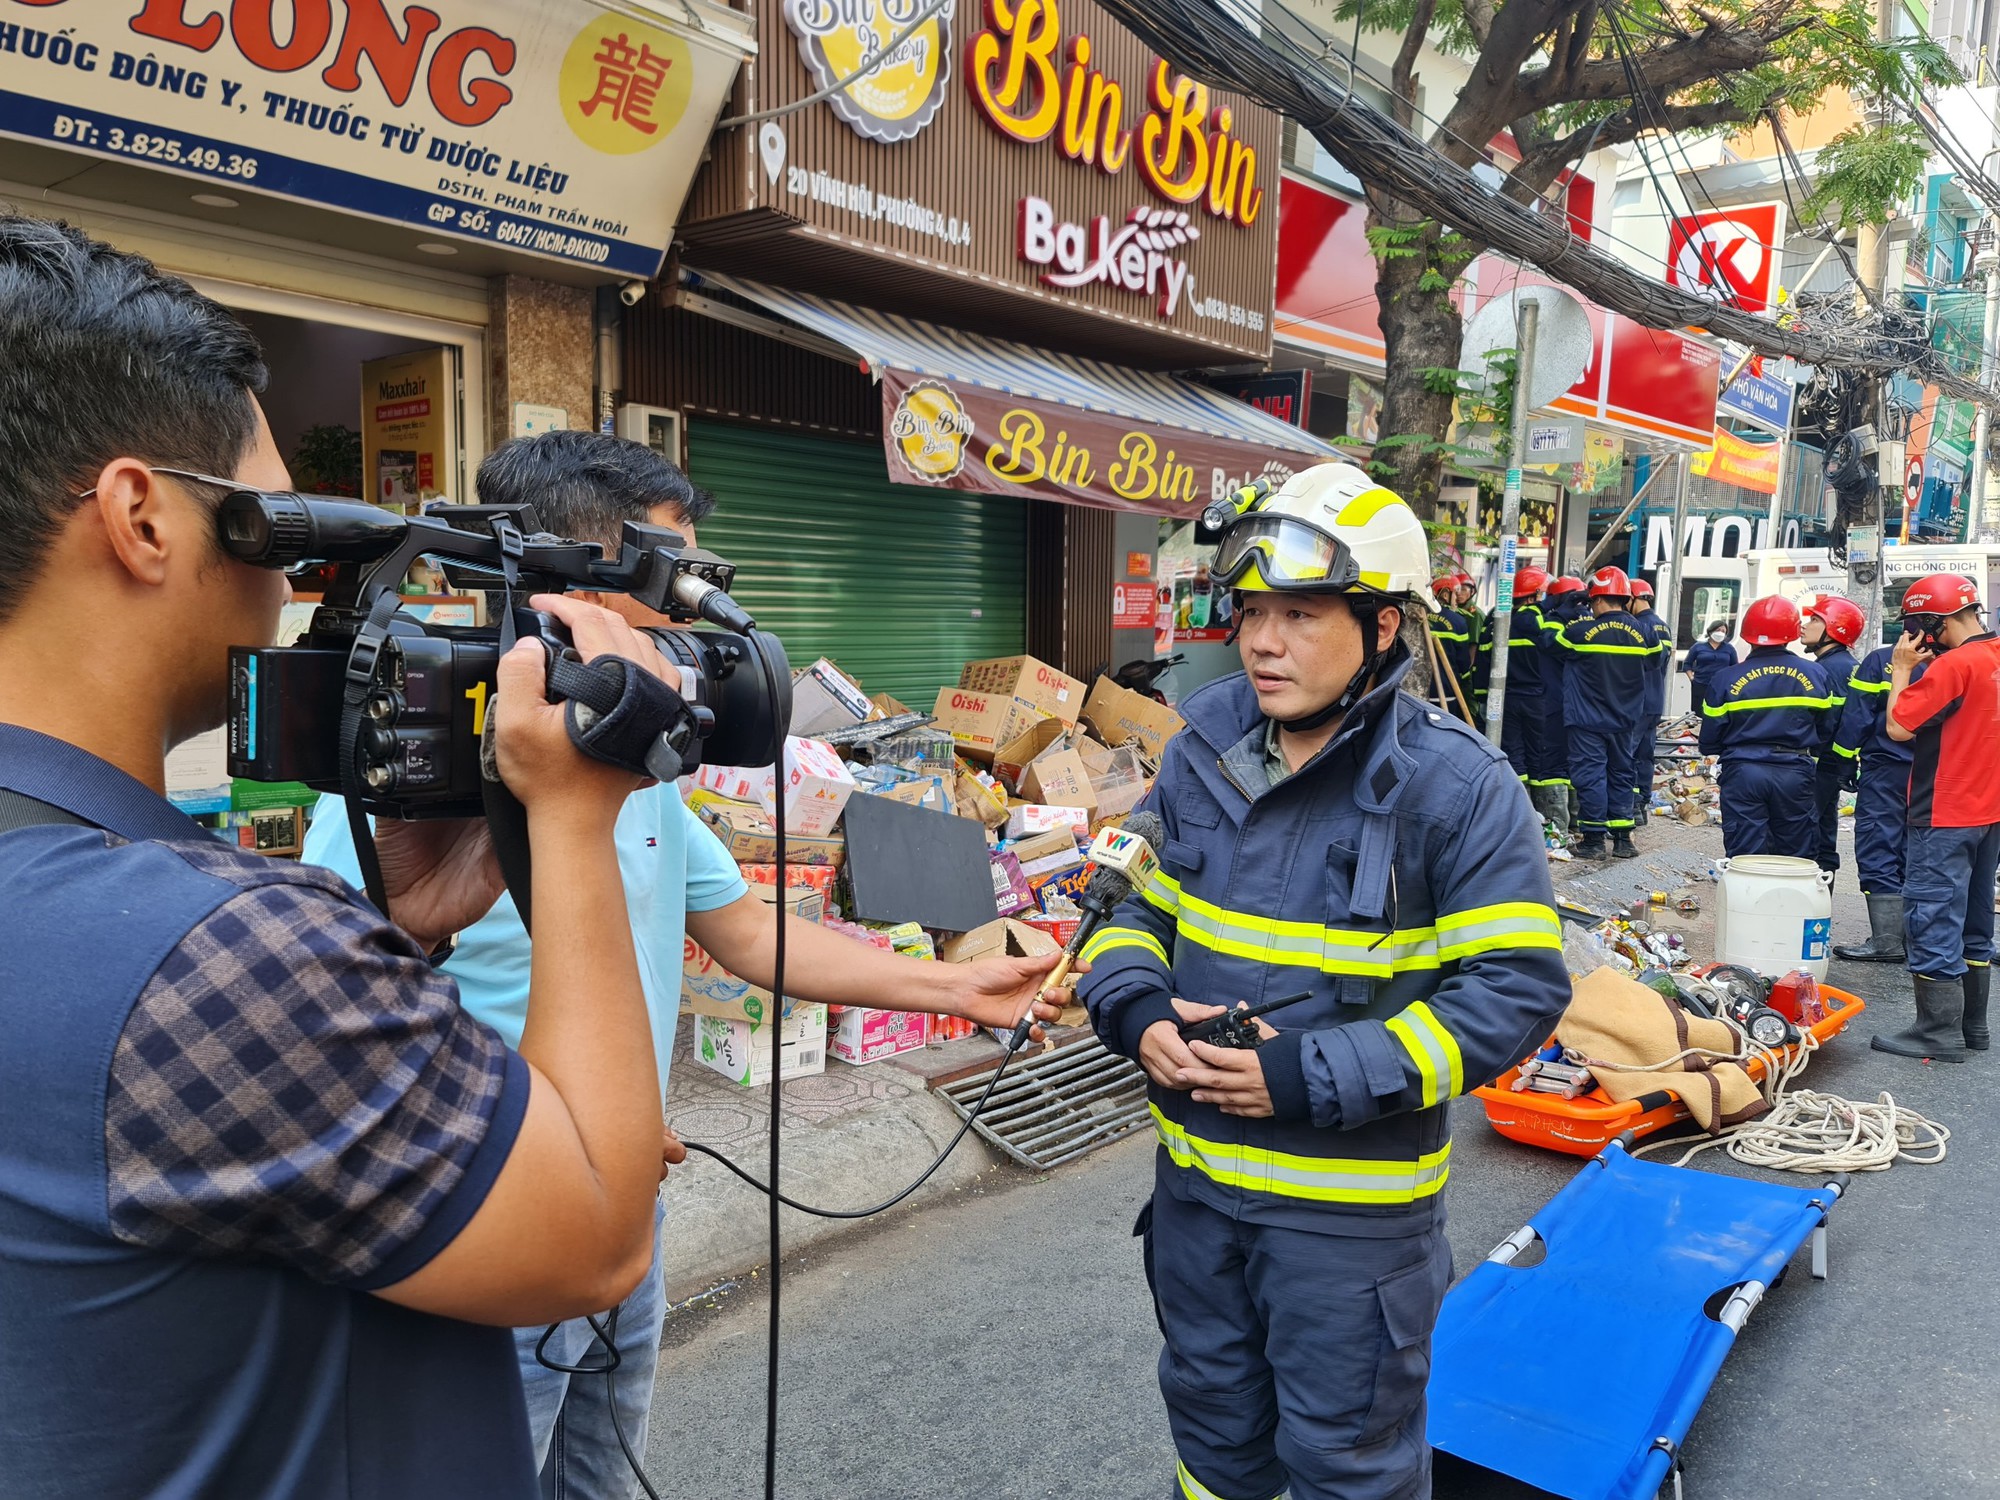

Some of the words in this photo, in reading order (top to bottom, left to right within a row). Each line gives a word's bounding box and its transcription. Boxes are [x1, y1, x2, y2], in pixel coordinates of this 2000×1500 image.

[579, 33, 674, 134] 龍
[109, 51, 208, 99] ĐÔNG
[221, 79, 247, 114] Y,
[263, 91, 370, 141] THUỐC
[380, 122, 425, 154] TỪ
[426, 136, 502, 178] DƯỢC
[506, 160, 570, 195] LIỆU
[965, 0, 1129, 173] Bin
[1136, 58, 1262, 226] Bin
[53, 115, 98, 145] ĐT:
[106, 127, 258, 179] 3.825.49.36
[437, 177, 488, 202] DSTH.
[494, 192, 543, 214] PHẠM
[592, 217, 629, 237] HOÀI
[787, 166, 808, 197] 20
[810, 170, 846, 208] VĨNH
[935, 213, 972, 246] 4,Q.4
[427, 203, 456, 222] GP
[458, 209, 492, 233] SỐ:
[496, 219, 611, 263] 6047/HCM-ĐKKDD
[1018, 196, 1187, 317] Bakery
[1205, 297, 1228, 321] 0834
[1247, 310, 1264, 331] 555
[379, 376, 426, 400] Maxxhair
[1732, 377, 1750, 397] PHỐ
[1750, 382, 1765, 403] VĂN
[1763, 391, 1779, 412] HÓA
[894, 410, 932, 436] Bin
[934, 410, 975, 435] Bin
[1238, 389, 1293, 424] NH
[985, 408, 1096, 489] Bin
[1108, 431, 1199, 503] Bin
[1904, 559, 1946, 572] CHỐNG
[1949, 562, 1977, 573] DỊCH
[1909, 600, 1925, 608] SGV
[1037, 667, 1069, 691] Oishi
[1730, 676, 1749, 696] CẢNH
[1746, 668, 1762, 681] SÁT
[1763, 666, 1786, 675] PCCC
[1786, 667, 1798, 678] VÀ
[1796, 672, 1814, 691] CNCH
[465, 681, 486, 735] 1
[951, 693, 987, 712] Oishi
[1116, 717, 1160, 743] AQUAFINA
[1061, 869, 1095, 895] Tig
